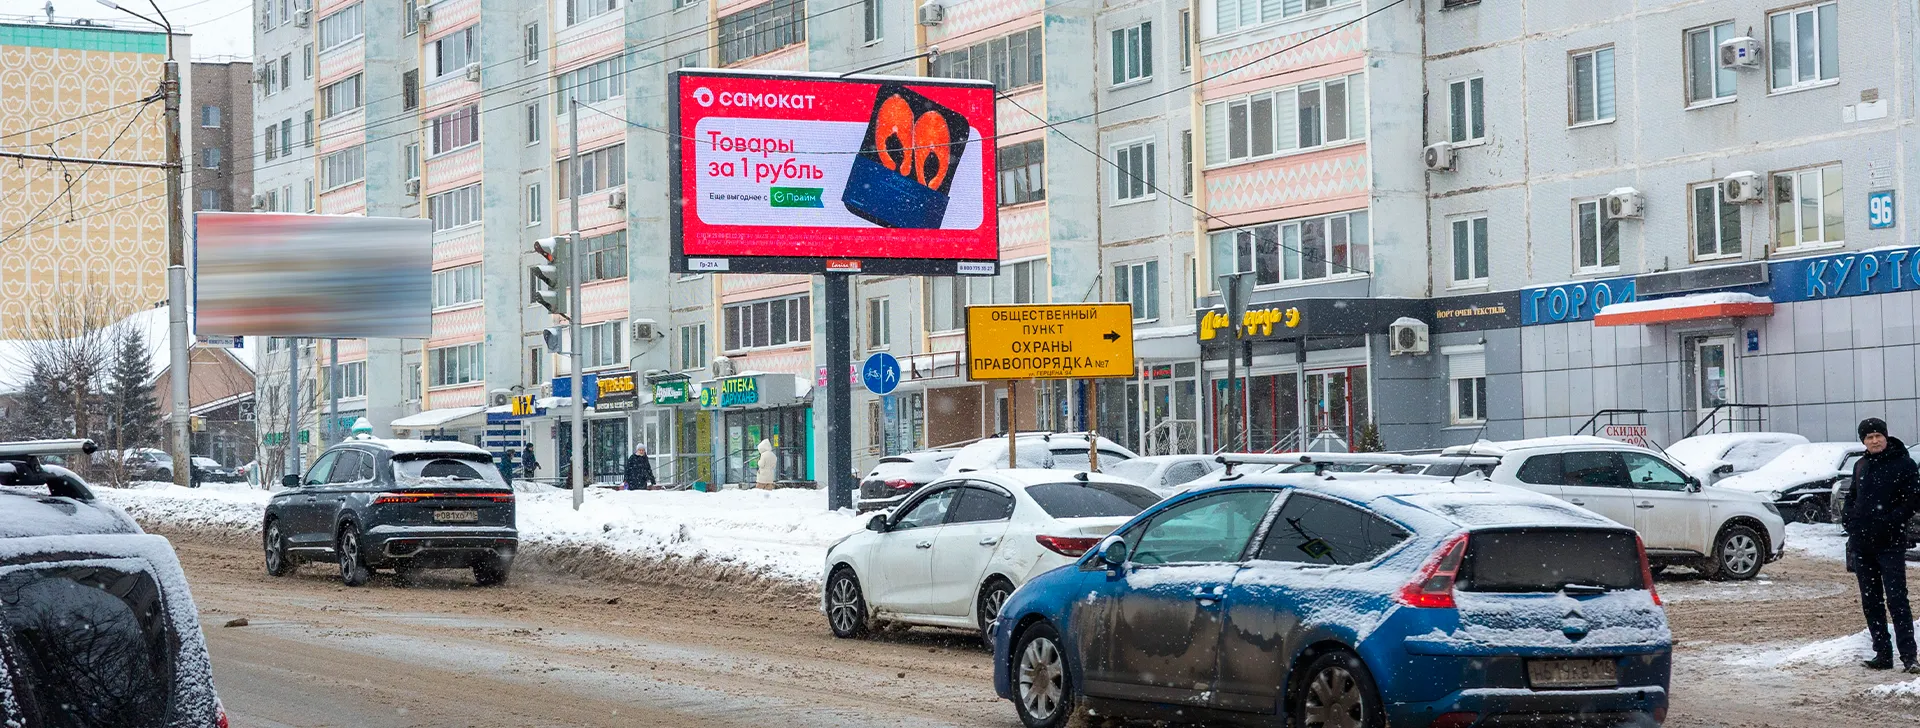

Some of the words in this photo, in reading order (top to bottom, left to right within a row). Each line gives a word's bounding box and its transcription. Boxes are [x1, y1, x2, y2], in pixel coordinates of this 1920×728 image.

[719, 91, 815, 109] самокат
[707, 130, 794, 158] Товары
[708, 161, 735, 177] за
[741, 157, 748, 178] 1
[755, 157, 824, 184] рубль
[709, 192, 725, 201] Еще
[726, 193, 761, 202] выгоднее
[786, 192, 816, 202] Прайм
[1870, 196, 1892, 225] 96
[991, 307, 1097, 322] ОБЩЕСТВЕННЫЙ
[1473, 306, 1506, 316] ТЕКСТИЛЬ
[1023, 324, 1064, 335] ПУНКТ
[1011, 340, 1073, 353] ОХРАНЫ
[974, 356, 1093, 371] ПРАВОПОРЯДКА
[721, 377, 755, 393] АПТЕКА
[1606, 426, 1647, 437] СКИДКИ
